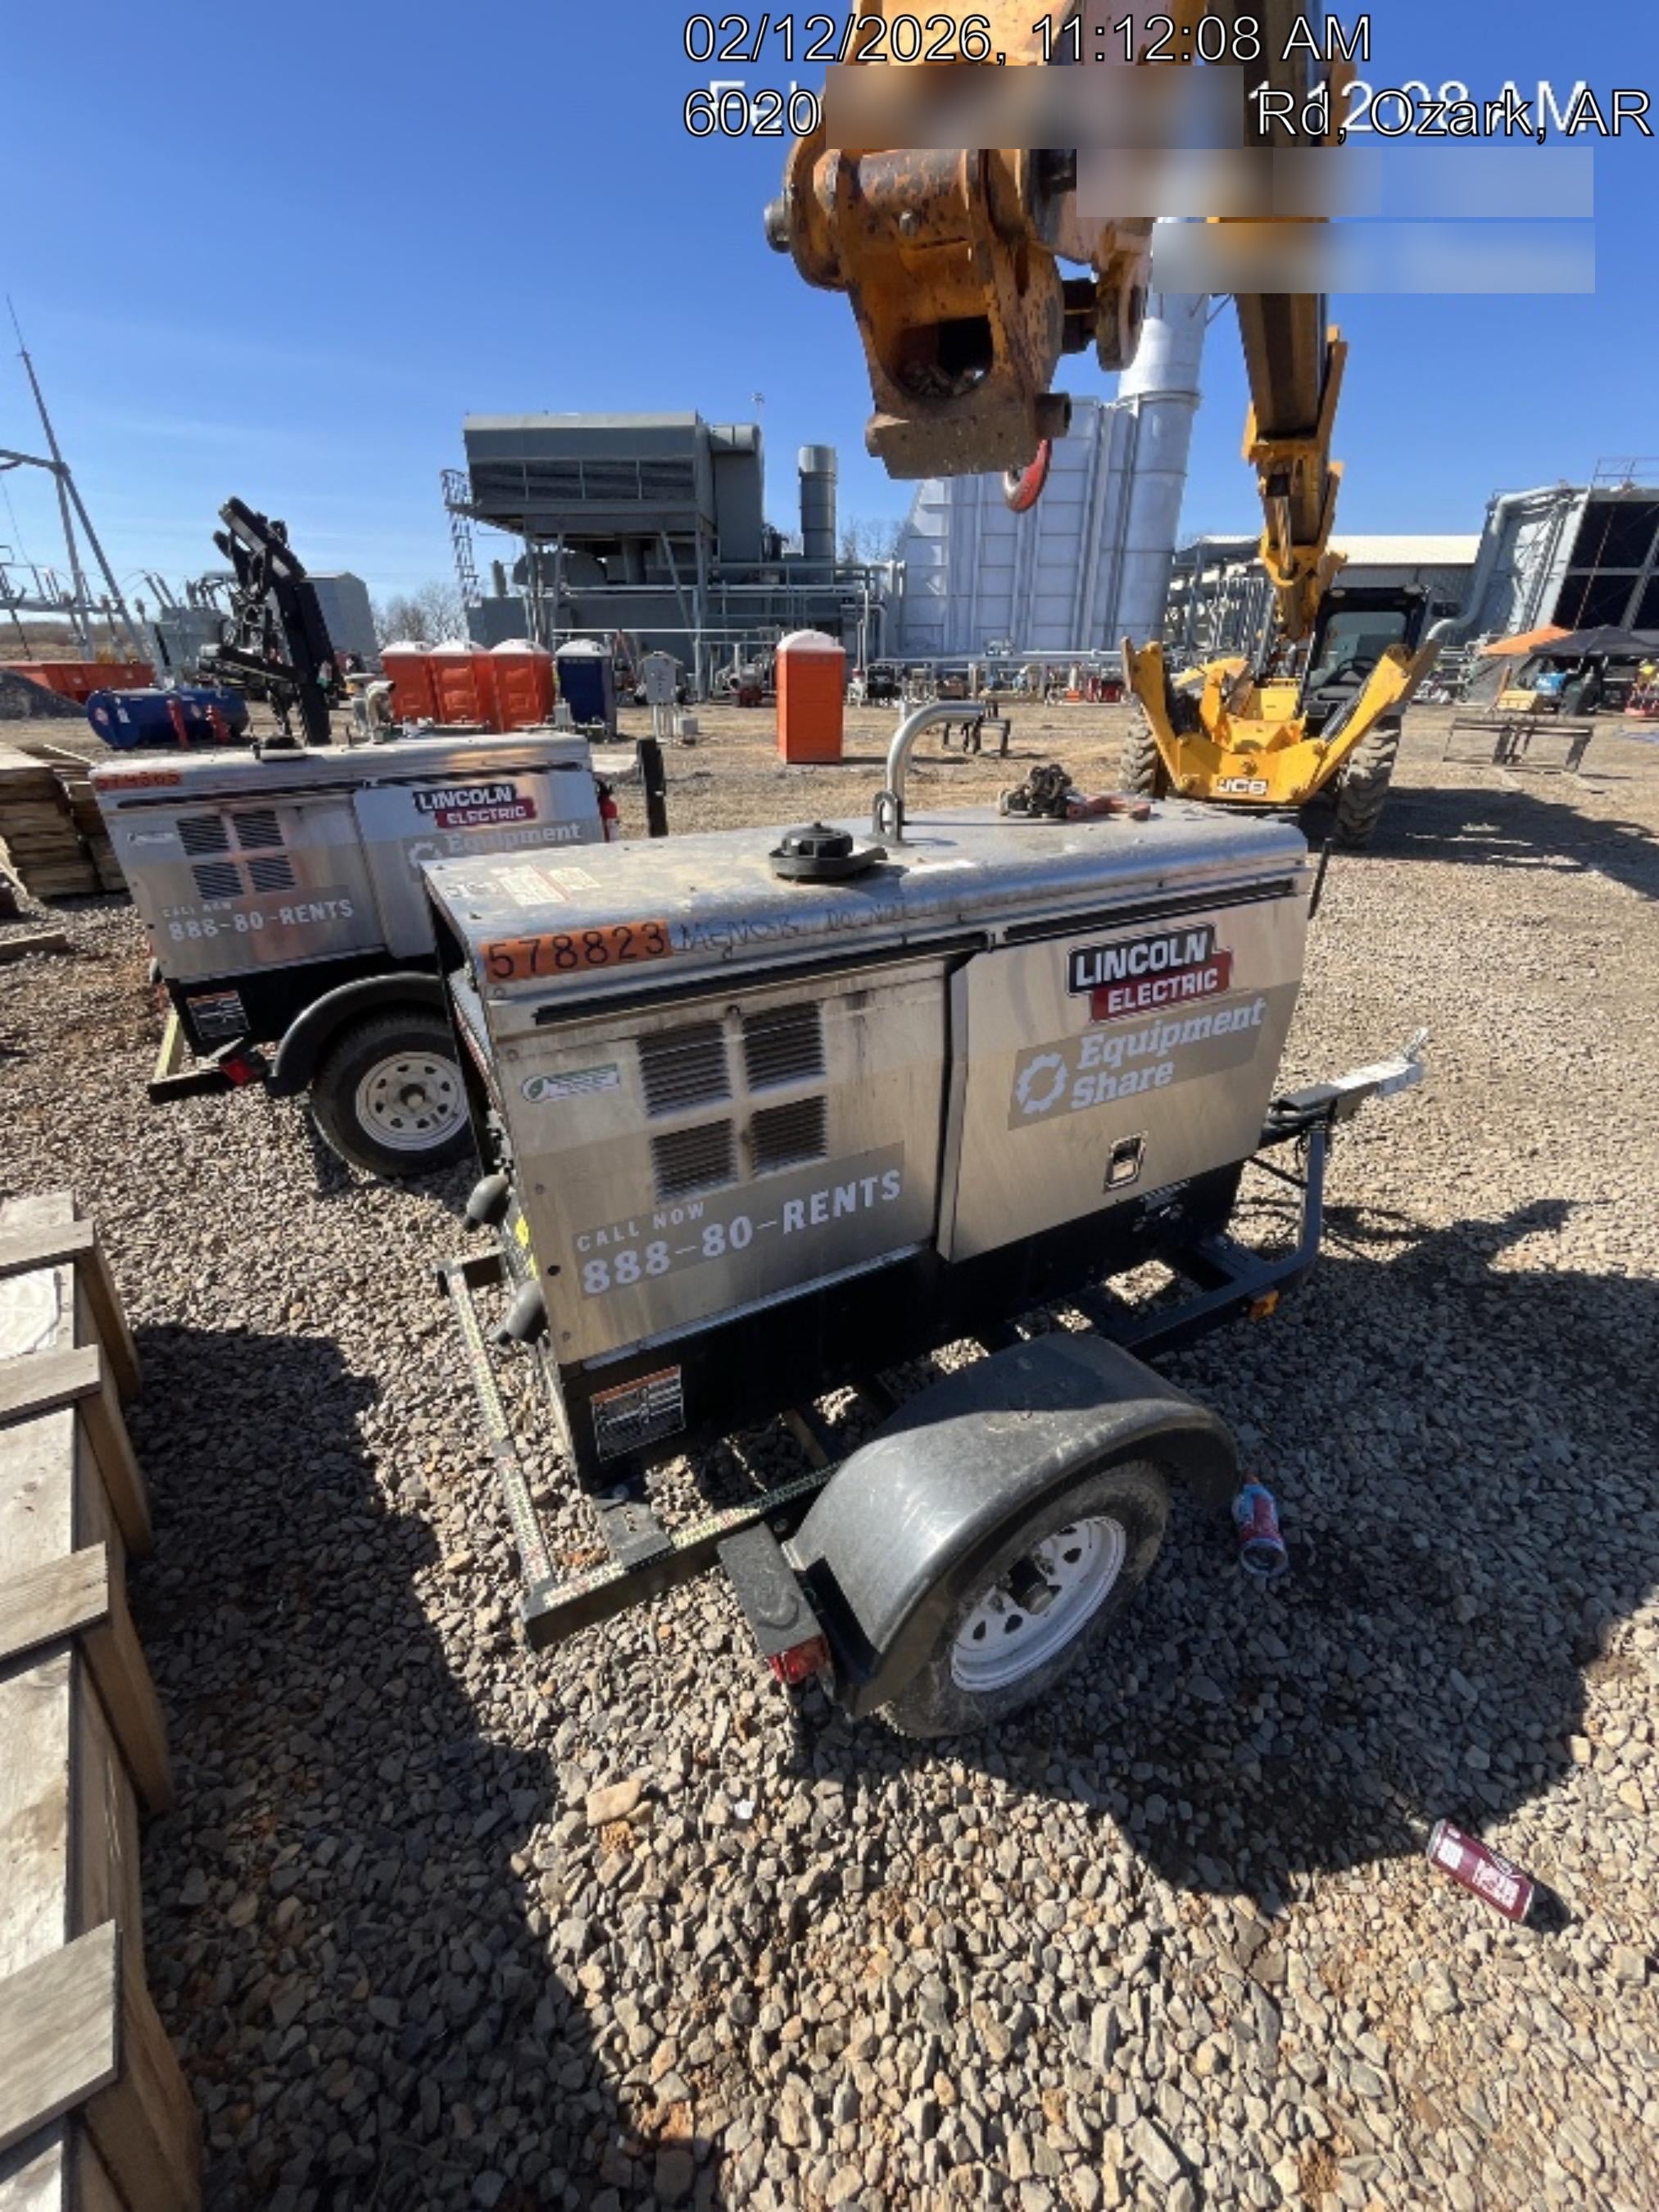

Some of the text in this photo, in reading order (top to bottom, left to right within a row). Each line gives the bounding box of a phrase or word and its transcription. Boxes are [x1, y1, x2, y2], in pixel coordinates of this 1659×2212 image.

[419, 786, 512, 809] LINCOLN
[1217, 777, 1267, 796] JCB
[445, 823, 581, 853] Equipment
[446, 806, 526, 824] ELECTRIC
[169, 899, 354, 941] 888-80-RENTS
[488, 921, 664, 978] 578823
[1075, 931, 1208, 986] LINCOLN
[1108, 968, 1218, 1013] ELECTRIC
[1077, 997, 1267, 1070] Equipment
[1072, 1061, 1175, 1108] Share
[577, 1202, 705, 1252] CALL NOW
[582, 1169, 901, 1294] 888-80-RENTS
